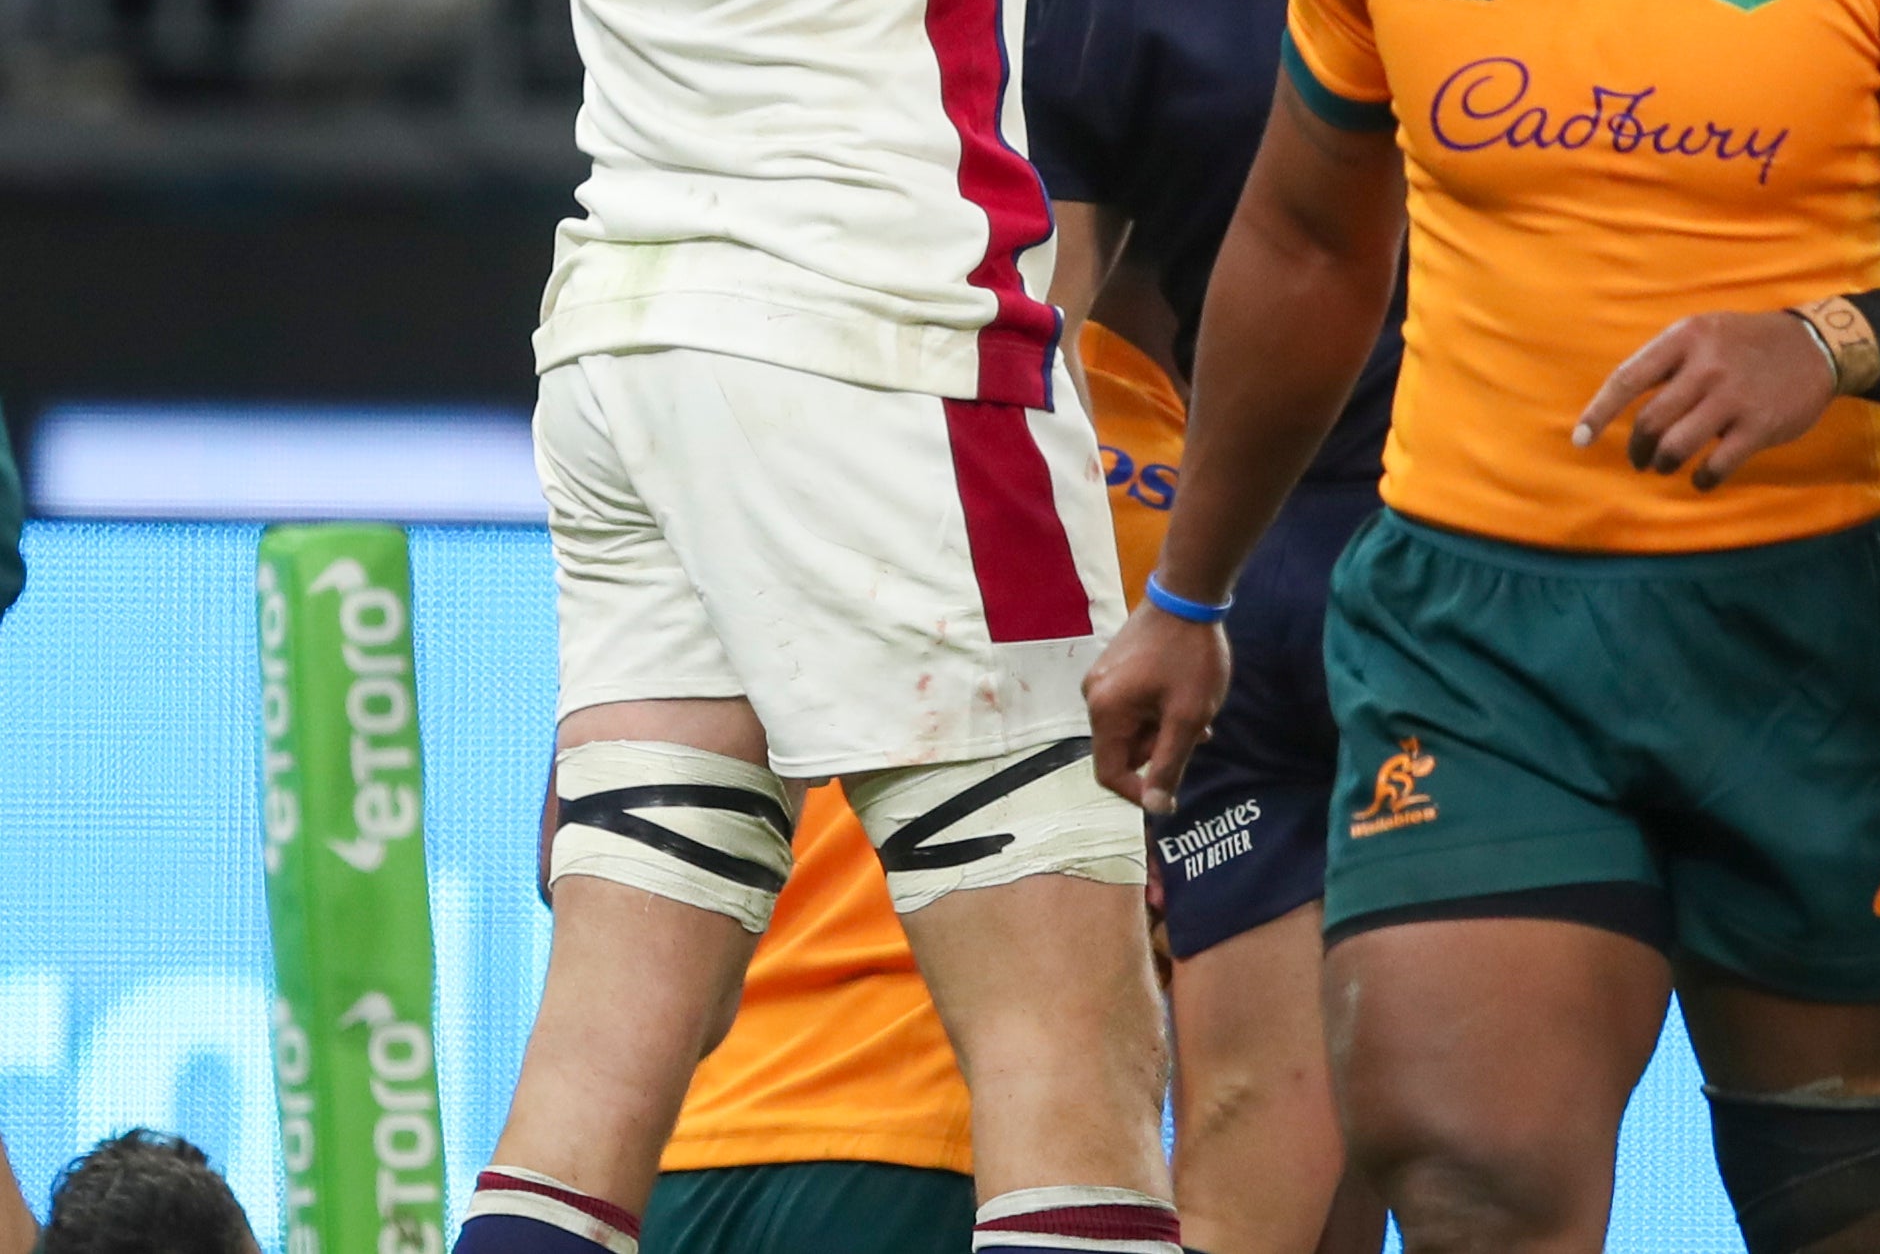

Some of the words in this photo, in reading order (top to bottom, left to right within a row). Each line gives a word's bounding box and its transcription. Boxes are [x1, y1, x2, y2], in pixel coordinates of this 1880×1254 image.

[1430, 56, 1790, 185] Cadbury
[1157, 798, 1262, 865] Emirates
[1184, 851, 1205, 882] FLY
[1206, 829, 1254, 870] BETTER
